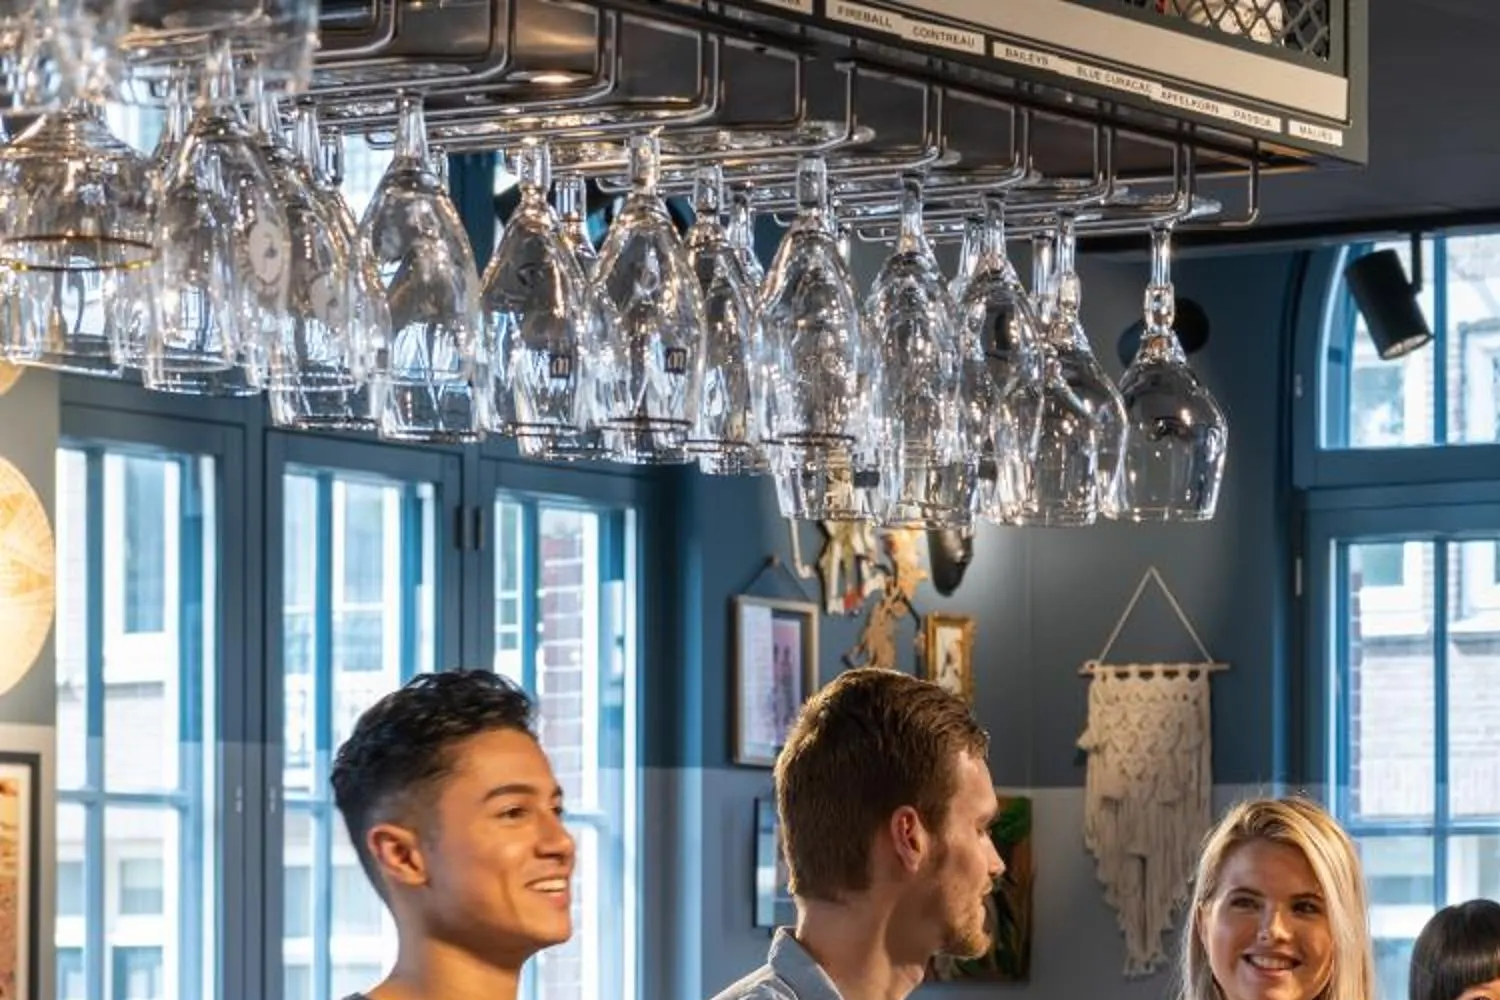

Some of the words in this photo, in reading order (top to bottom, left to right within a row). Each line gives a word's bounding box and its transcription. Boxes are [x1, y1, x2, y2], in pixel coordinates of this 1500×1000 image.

[836, 5, 893, 28] FIREBALL
[912, 25, 976, 48] COINTREAU
[1004, 47, 1049, 66] BAILEYS
[1076, 65, 1100, 81] BLUE
